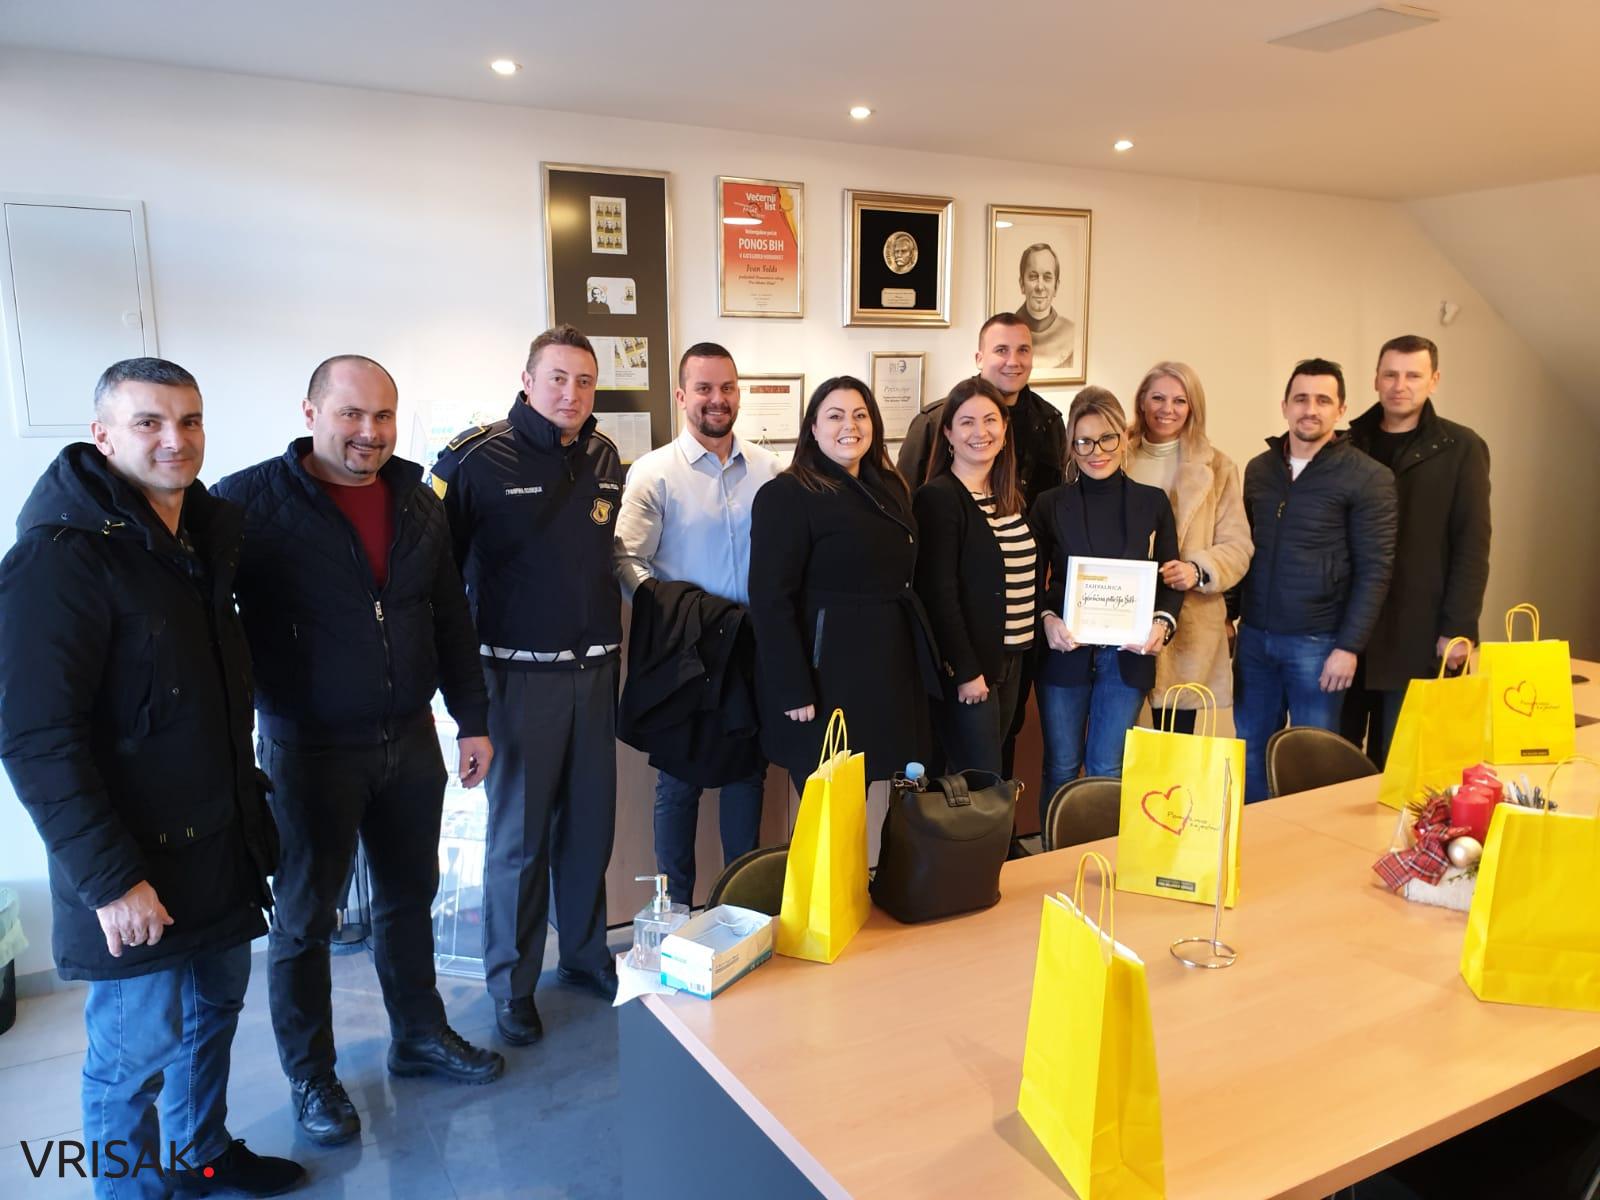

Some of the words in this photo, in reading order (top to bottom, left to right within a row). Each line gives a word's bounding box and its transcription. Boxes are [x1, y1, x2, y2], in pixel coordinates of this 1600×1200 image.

[745, 192, 777, 203] Večernji
[764, 202, 776, 211] list
[738, 237, 768, 250] PONOS
[768, 239, 785, 251] BIH
[1085, 583, 1122, 591] ZAHVALNICA
